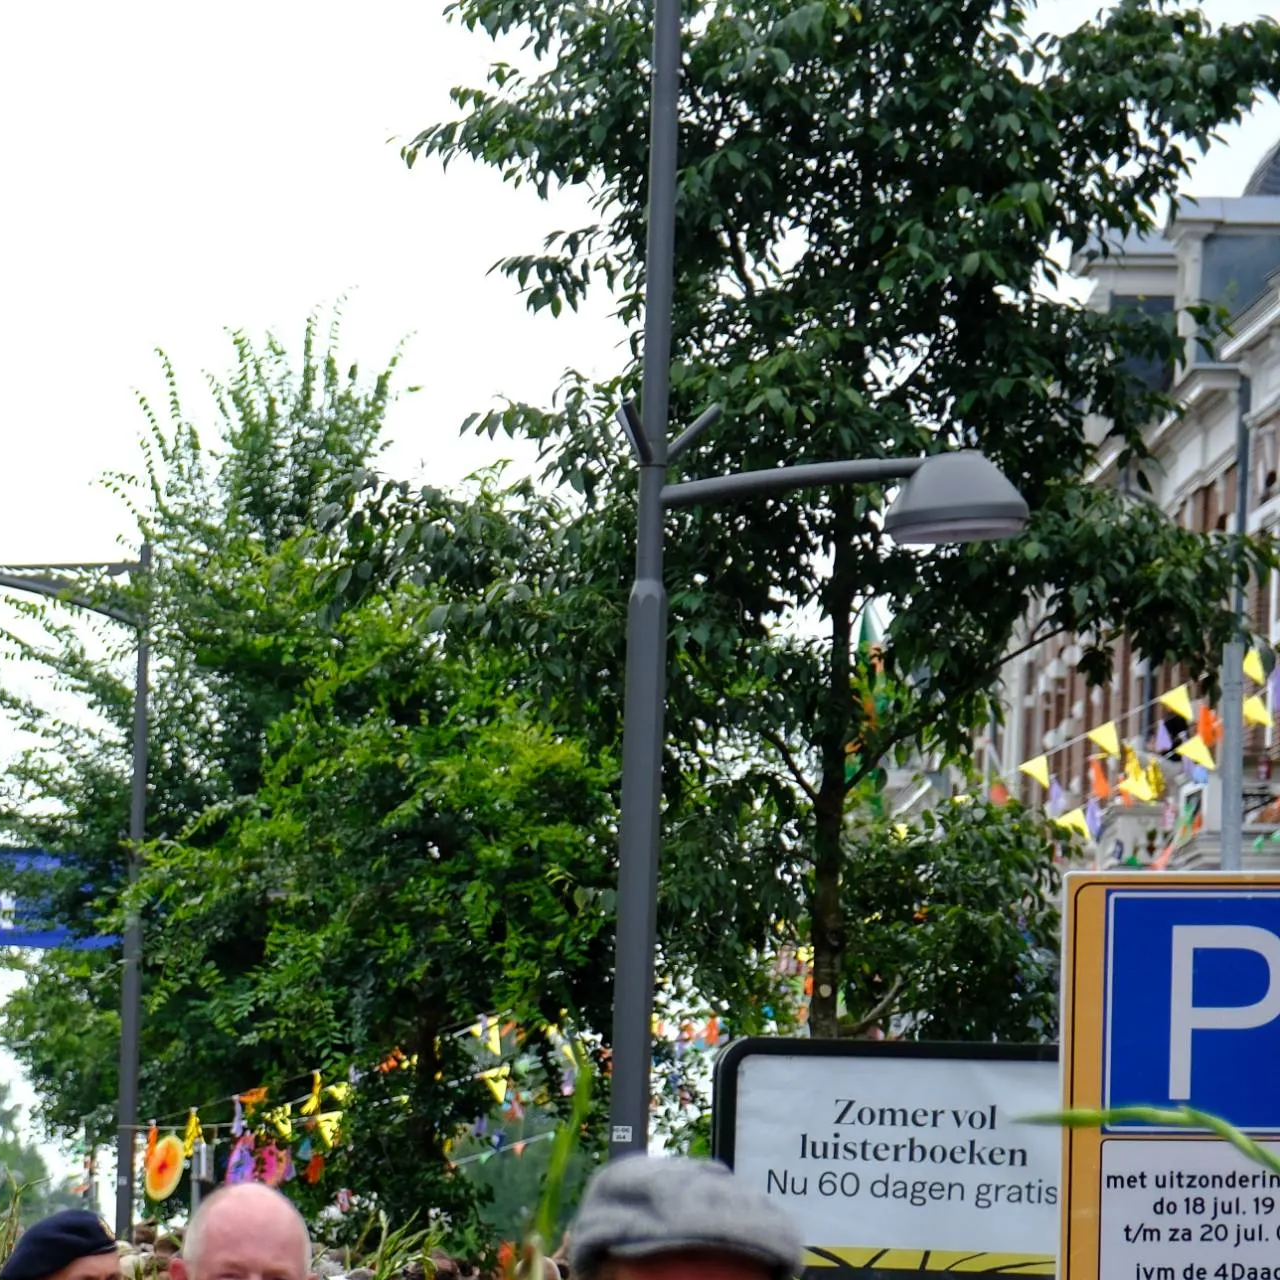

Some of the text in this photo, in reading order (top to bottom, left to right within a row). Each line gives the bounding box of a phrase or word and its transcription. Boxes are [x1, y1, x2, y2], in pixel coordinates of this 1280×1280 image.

[1169, 925, 1280, 1099] P
[833, 1098, 997, 1130] Zomer vol
[800, 1132, 1028, 1167] luisterboeken
[767, 1169, 1057, 1209] Nu 60 dagen gratis
[1106, 1171, 1147, 1189] met
[1153, 1197, 1276, 1221] do 18 jul. 19
[1124, 1223, 1161, 1244] t/m
[1168, 1227, 1192, 1242] za
[1200, 1223, 1228, 1242] 20
[1234, 1224, 1270, 1248] jul.
[1136, 1263, 1175, 1280] ivm
[1183, 1263, 1207, 1280] de
